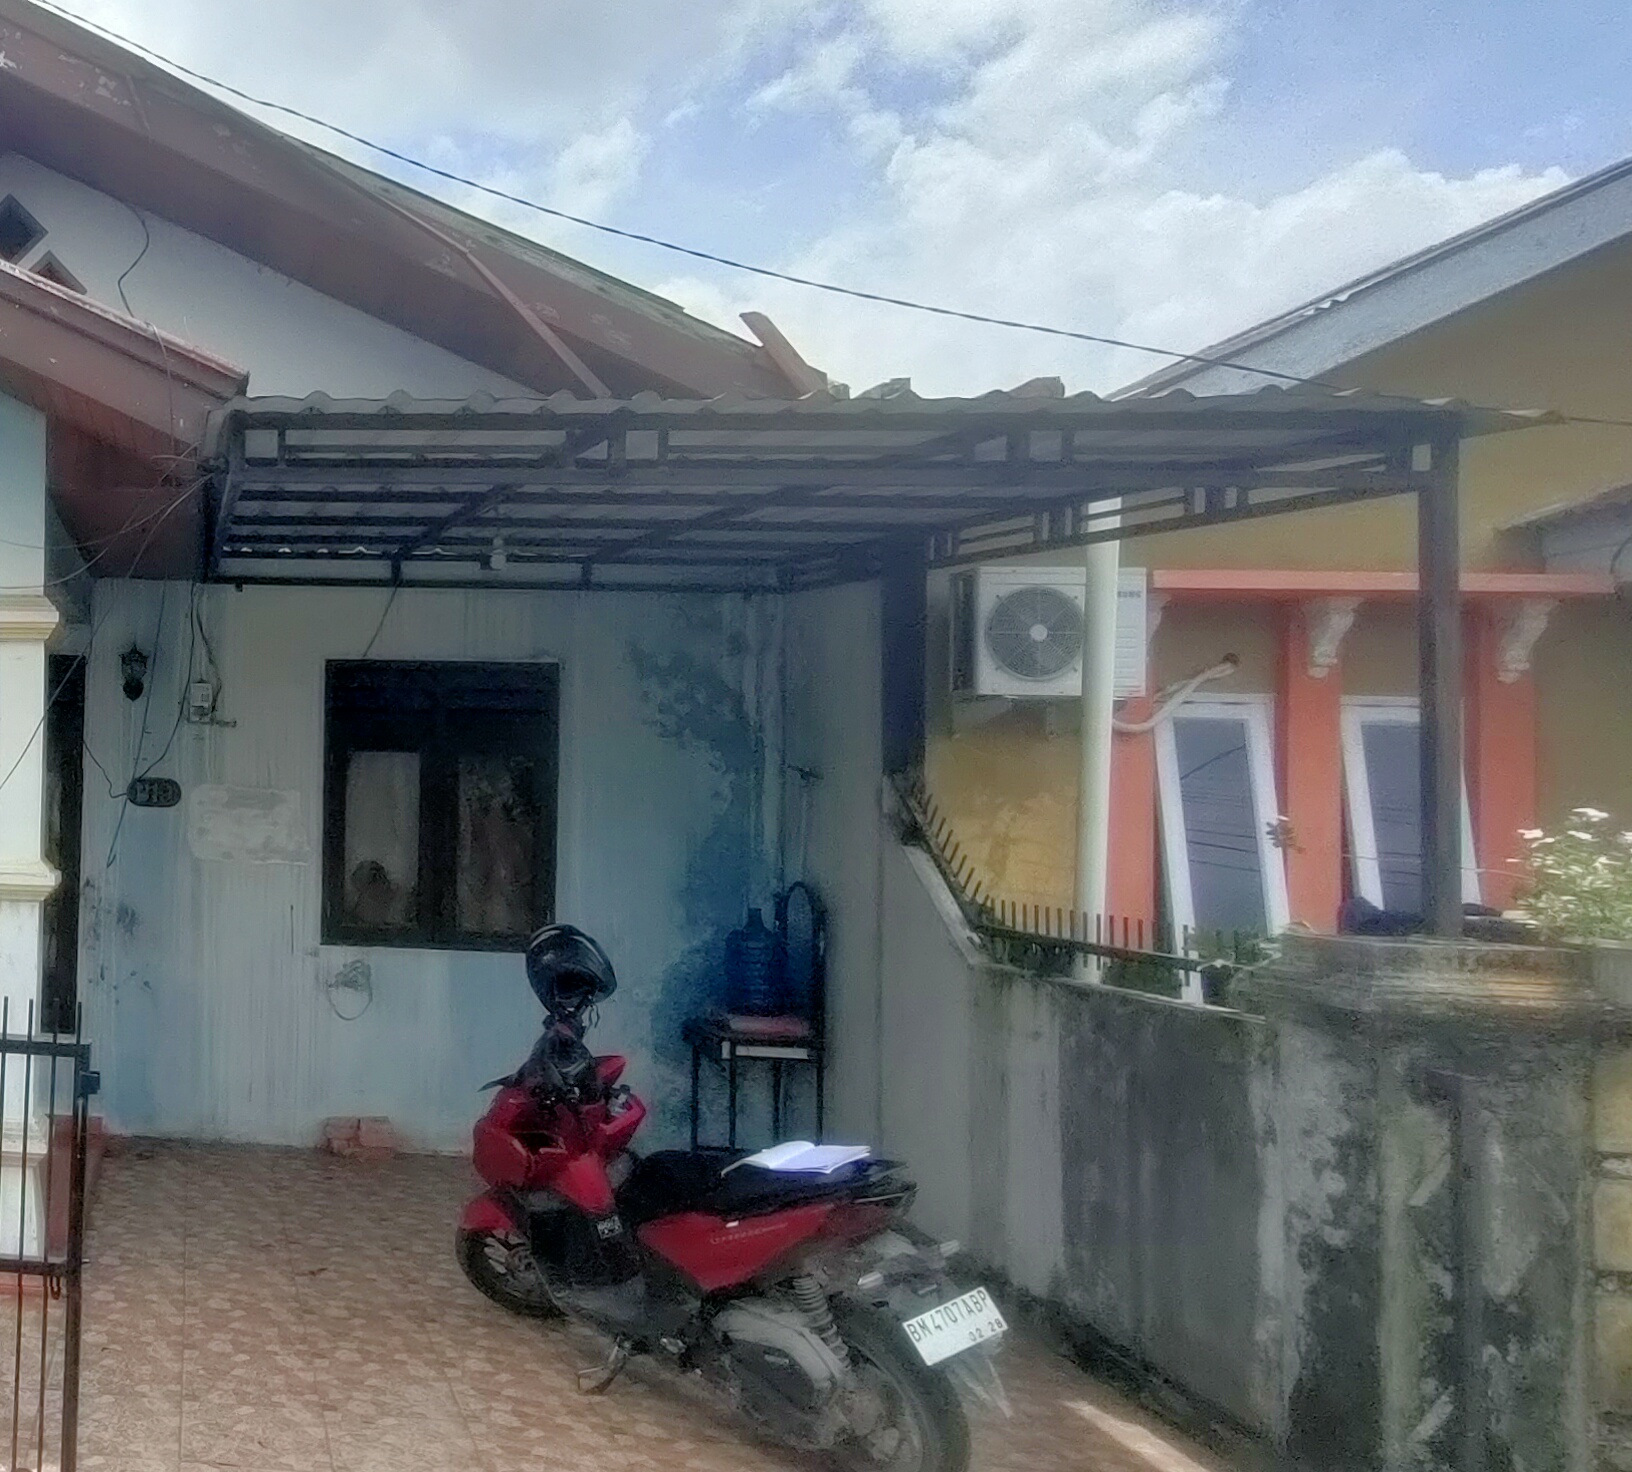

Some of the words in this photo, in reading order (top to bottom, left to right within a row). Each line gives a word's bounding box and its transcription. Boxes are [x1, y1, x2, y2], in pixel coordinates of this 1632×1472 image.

[906, 1317, 933, 1343] BM
[929, 1301, 965, 1332] 4707
[961, 1289, 988, 1316] ABP
